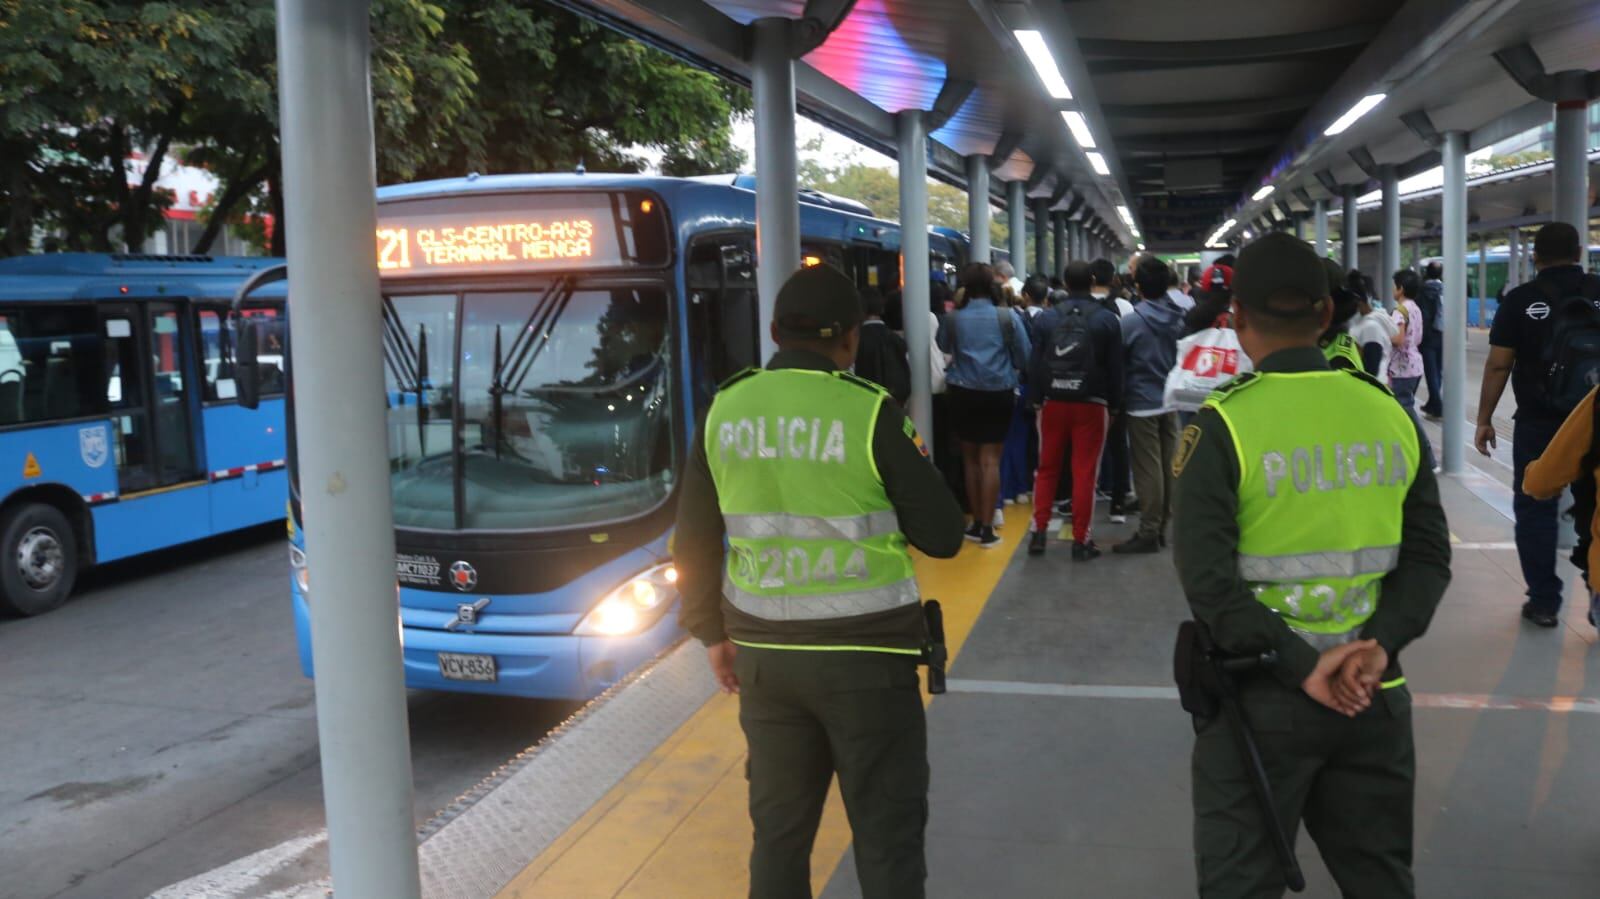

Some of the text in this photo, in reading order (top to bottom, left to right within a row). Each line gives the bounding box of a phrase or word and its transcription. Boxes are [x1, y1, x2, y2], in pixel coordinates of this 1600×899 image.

[424, 238, 592, 265] TERMINAL MENGA
[1051, 378, 1082, 390] NIKE
[719, 416, 845, 464] POLICIA
[1263, 439, 1408, 497] POLICIA
[440, 655, 493, 675] VCV-836
